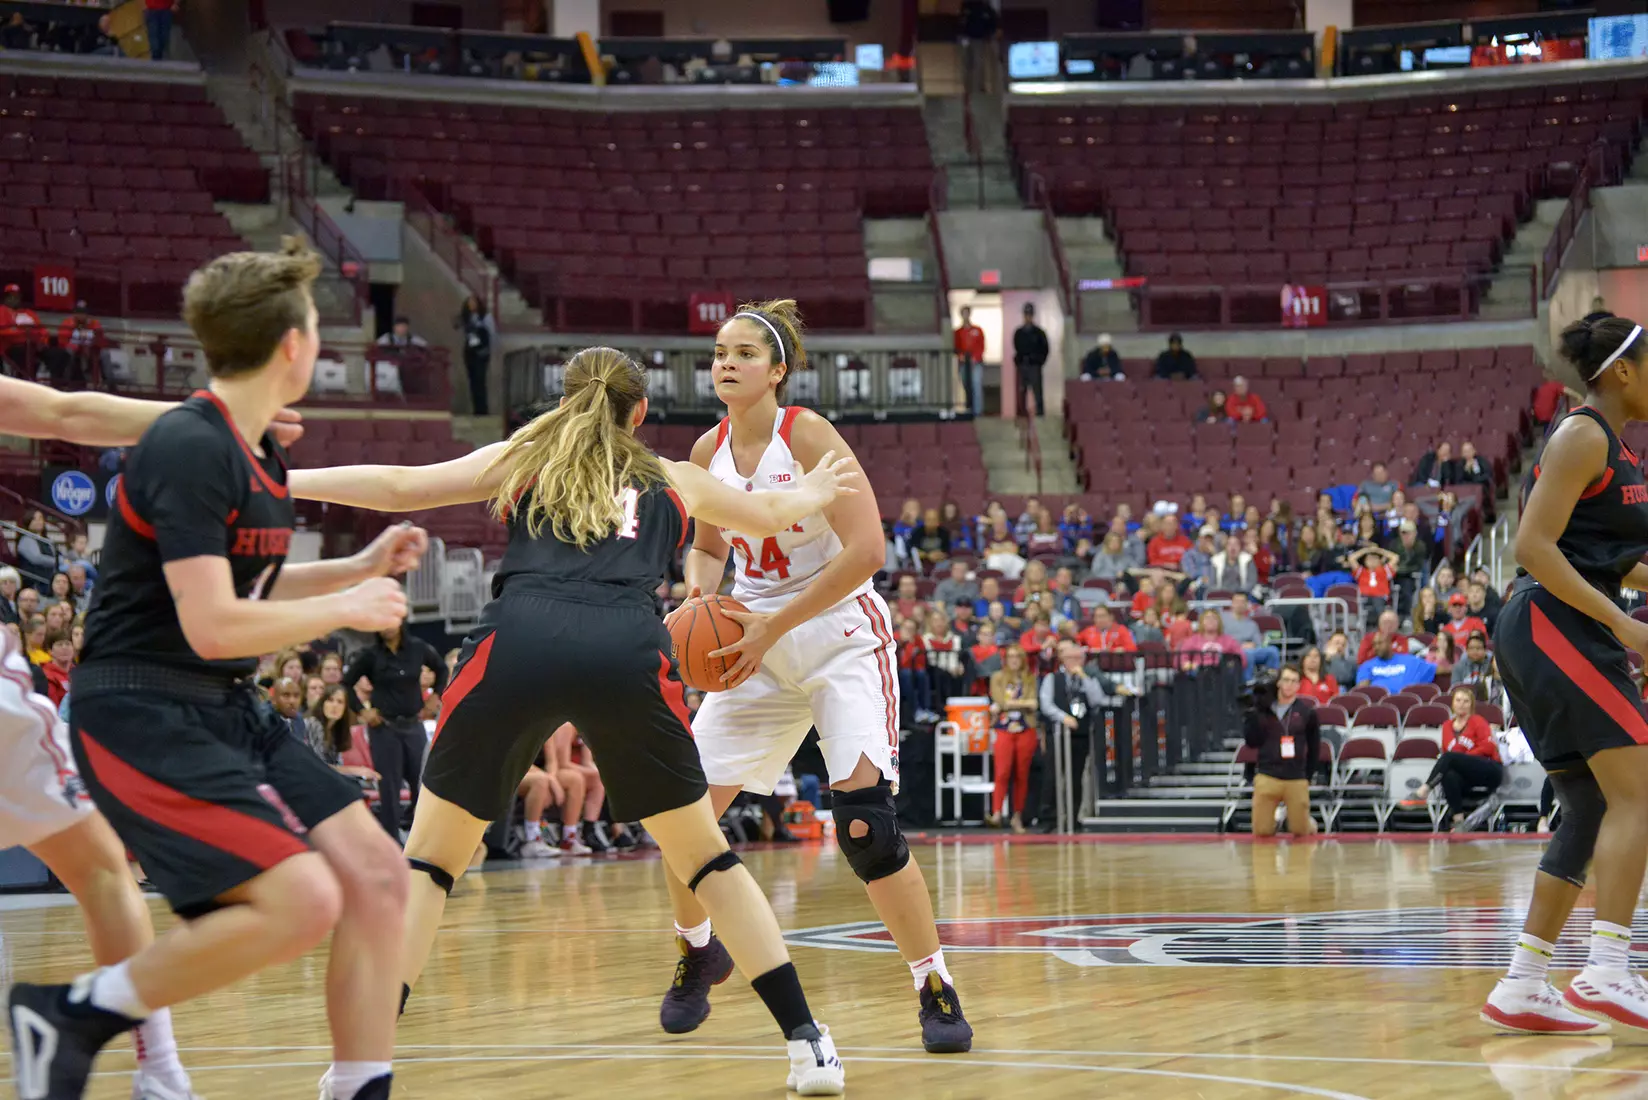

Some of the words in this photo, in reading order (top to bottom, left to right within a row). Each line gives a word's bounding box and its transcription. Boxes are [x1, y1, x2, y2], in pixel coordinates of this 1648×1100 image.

[40, 276, 69, 297] 110
[697, 302, 726, 322] 111
[731, 536, 791, 580] 24
